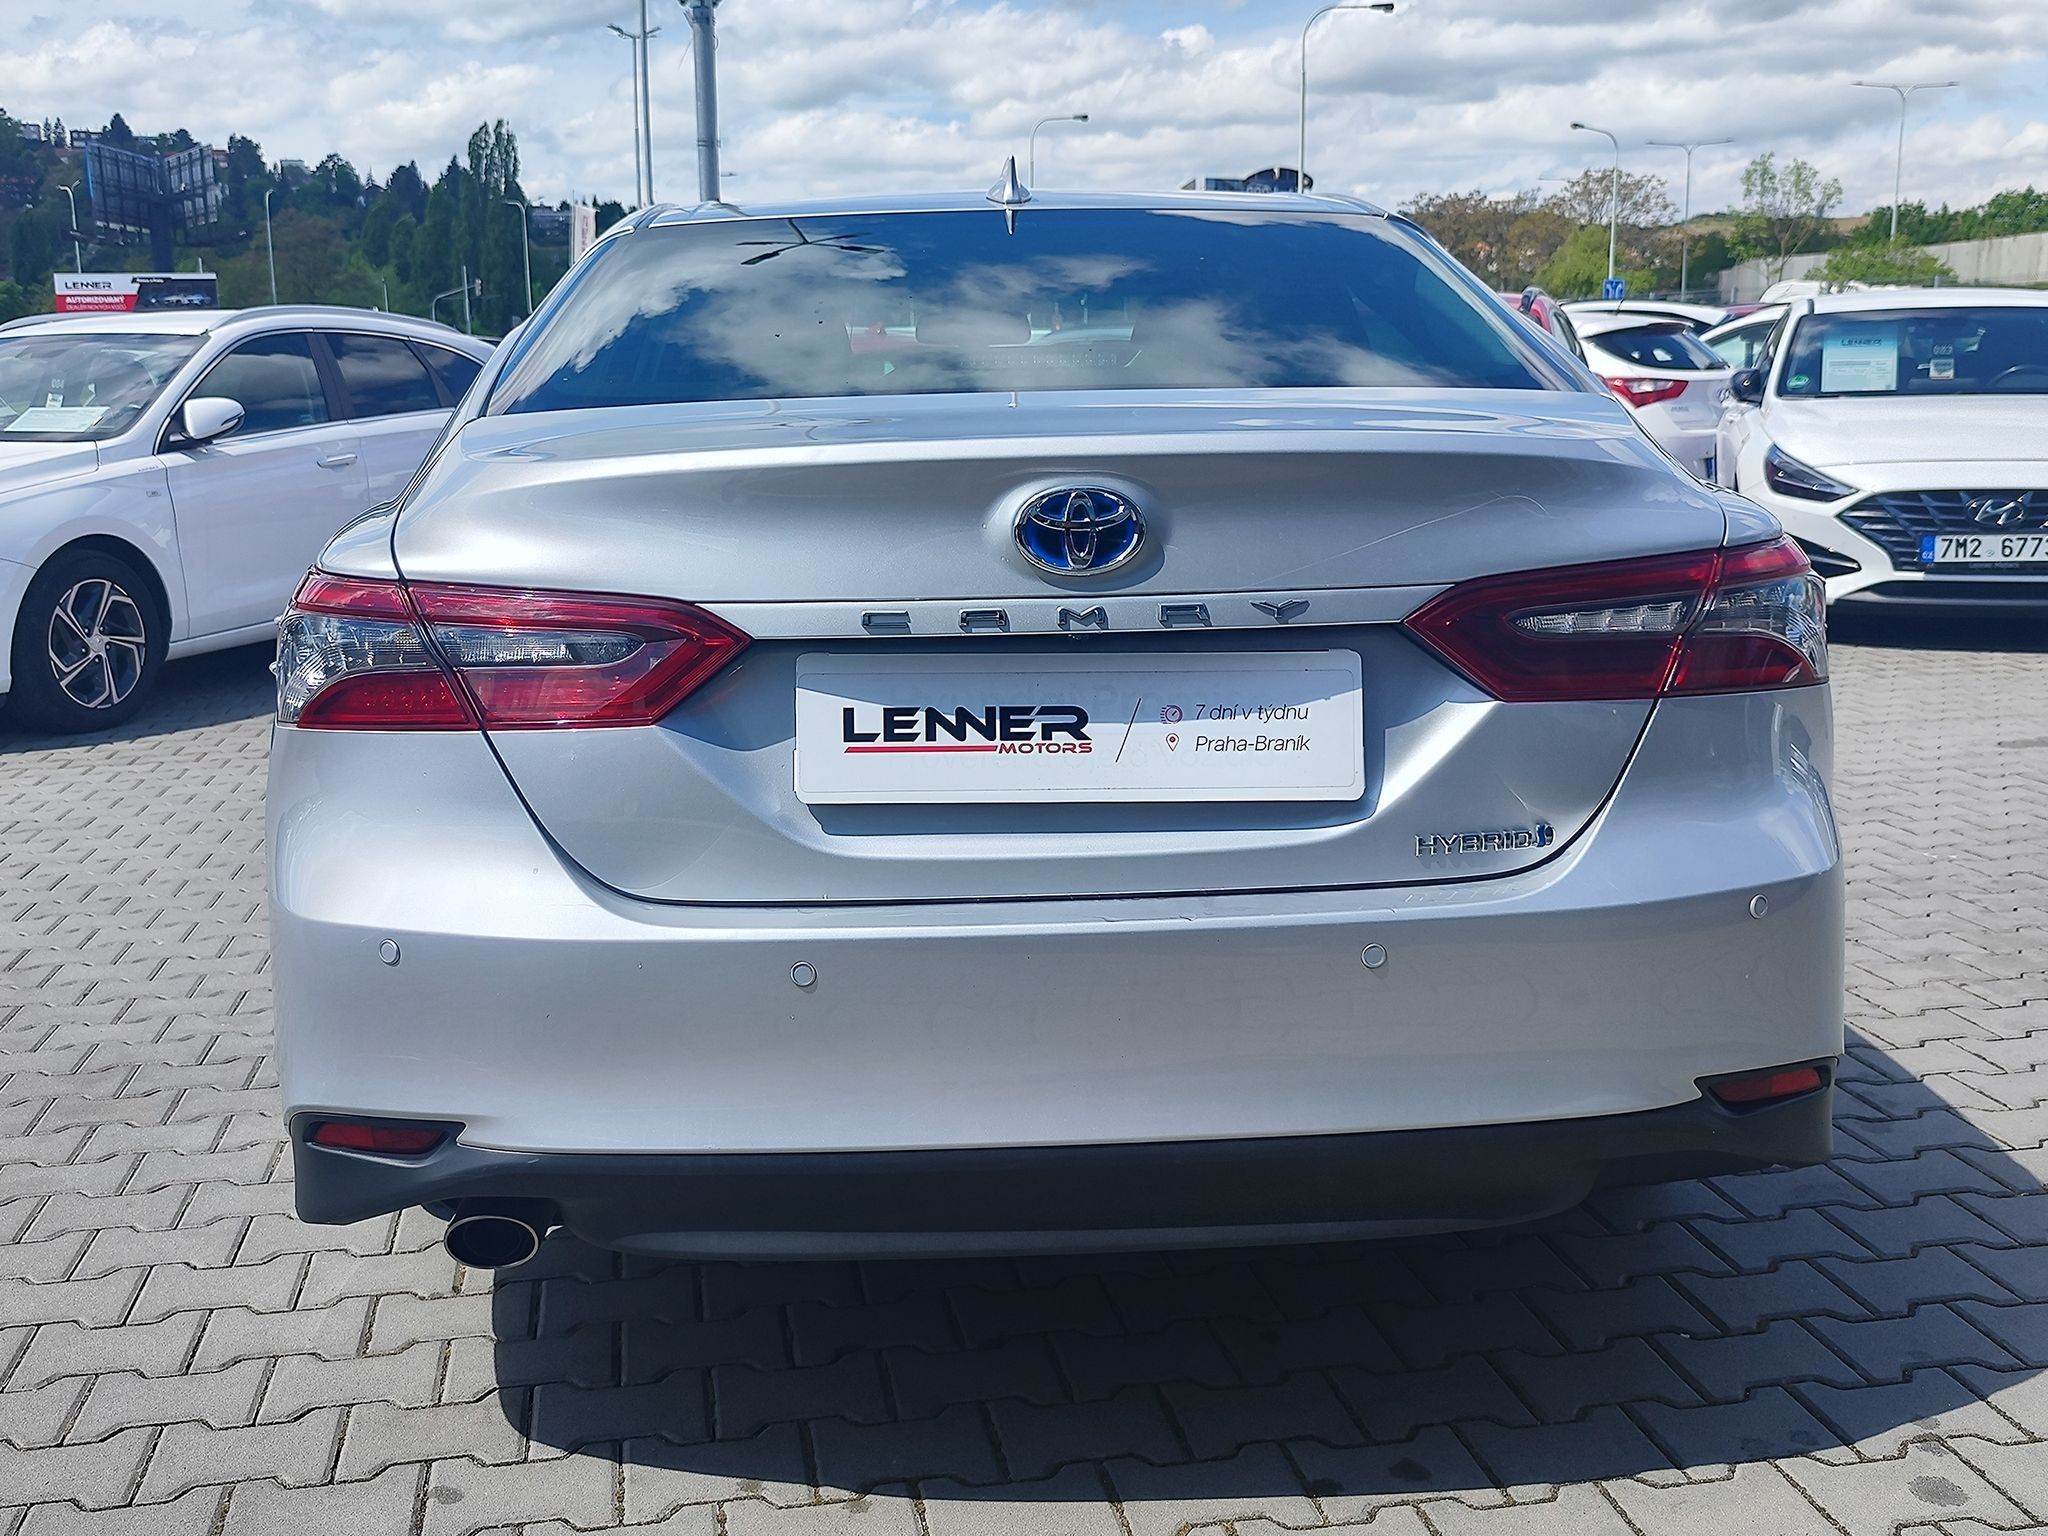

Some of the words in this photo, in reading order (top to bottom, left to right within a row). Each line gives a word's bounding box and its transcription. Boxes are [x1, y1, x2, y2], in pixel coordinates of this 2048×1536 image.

[64, 281, 112, 290] LENNER
[1941, 537, 1982, 558] 7M2
[861, 599, 1309, 629] CAMRY
[842, 705, 1092, 742] LENNER
[1195, 703, 1206, 720] 7
[1209, 703, 1239, 720] dní
[1242, 707, 1253, 720] v
[1257, 703, 1309, 724] týdnu
[998, 742, 1093, 754] MOTORS
[1195, 734, 1311, 752] Praha-Braník
[1415, 829, 1533, 857] HYBRID
